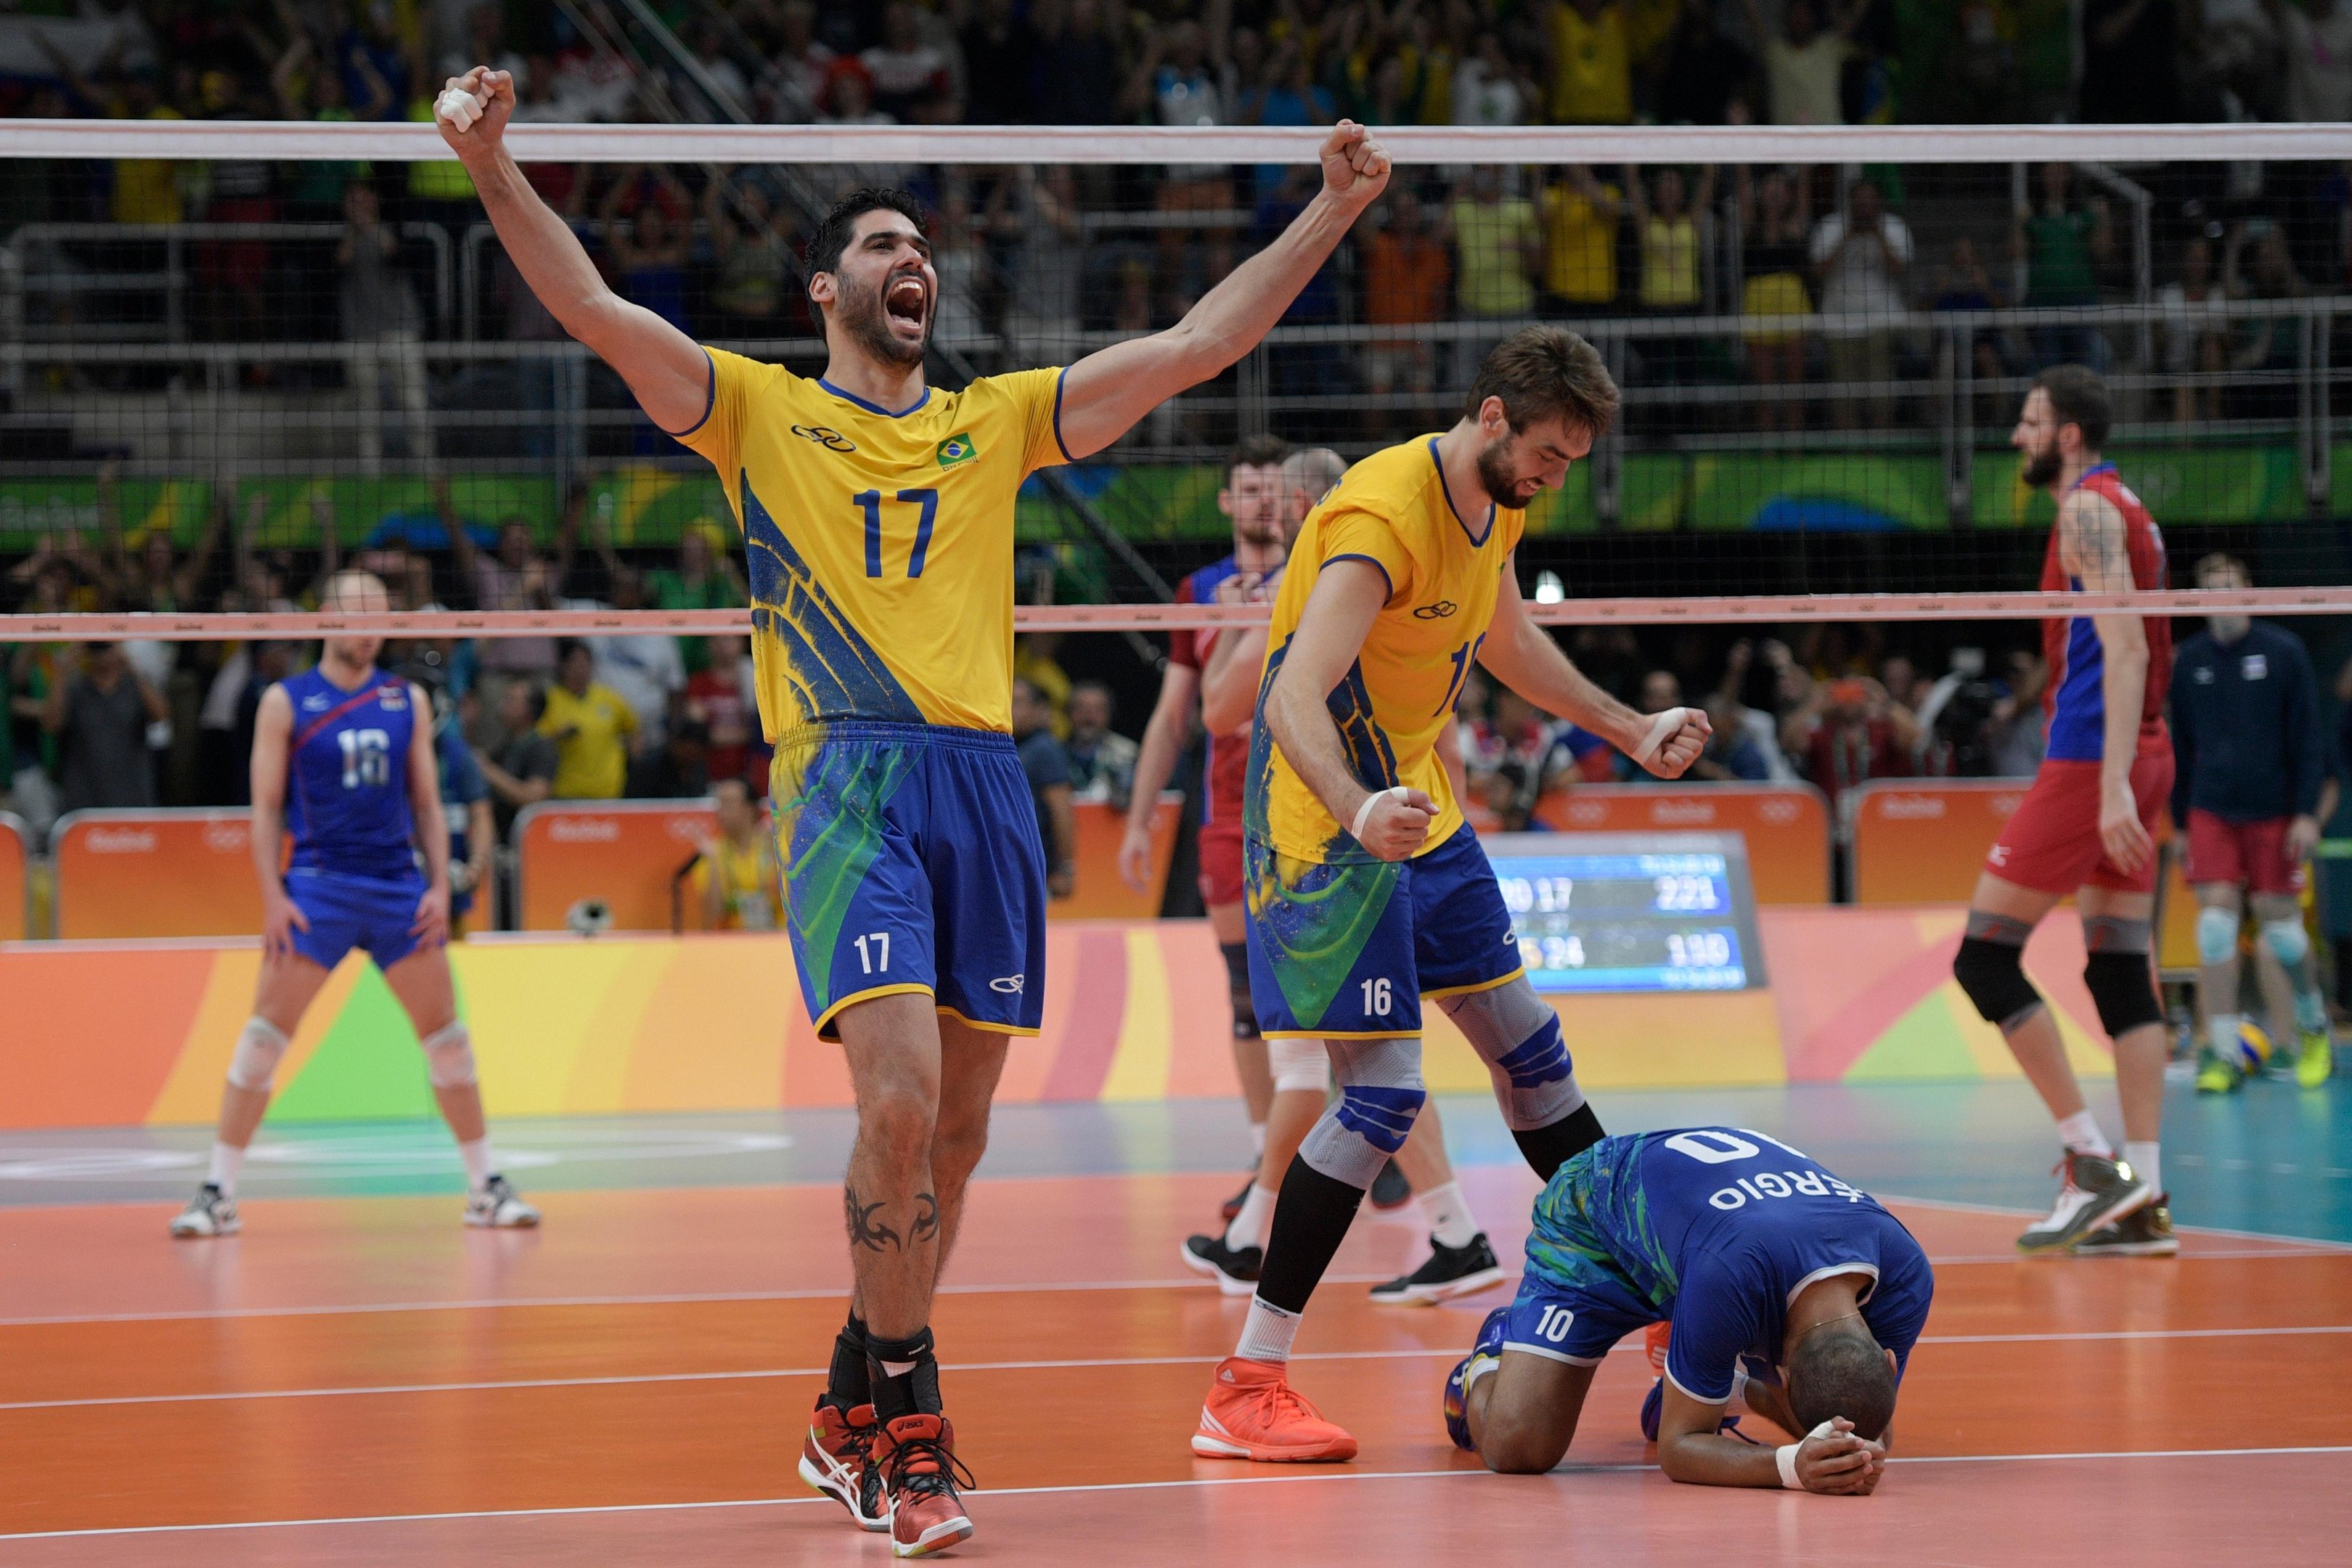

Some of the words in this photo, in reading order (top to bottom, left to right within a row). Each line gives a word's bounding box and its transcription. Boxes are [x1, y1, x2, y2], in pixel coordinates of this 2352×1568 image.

[853, 489, 939, 578] 17
[854, 932, 889, 974] 17
[1360, 977, 1392, 1016] 16
[1535, 1304, 1575, 1342] 10
